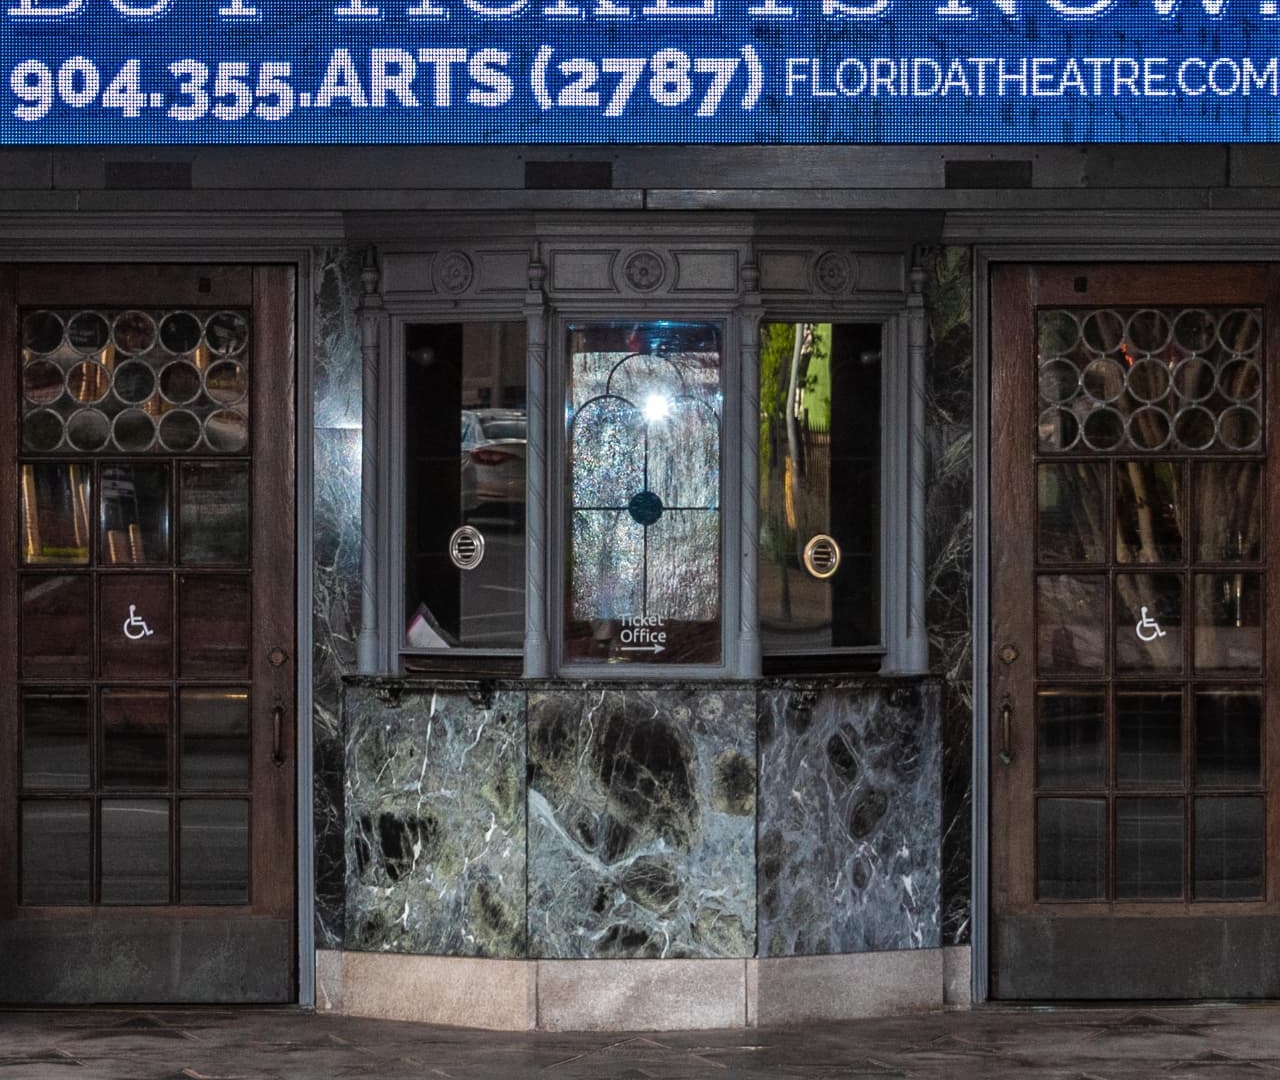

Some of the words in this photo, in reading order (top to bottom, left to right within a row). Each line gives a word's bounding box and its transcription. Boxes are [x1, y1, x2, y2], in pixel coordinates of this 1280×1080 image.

[10, 47, 516, 121] 904.355.ARTS
[530, 45, 764, 118] (2787)
[785, 56, 1280, 97] FLORIDATHEATRE.COM
[619, 612, 665, 627] Ticket
[620, 628, 667, 643] Office
